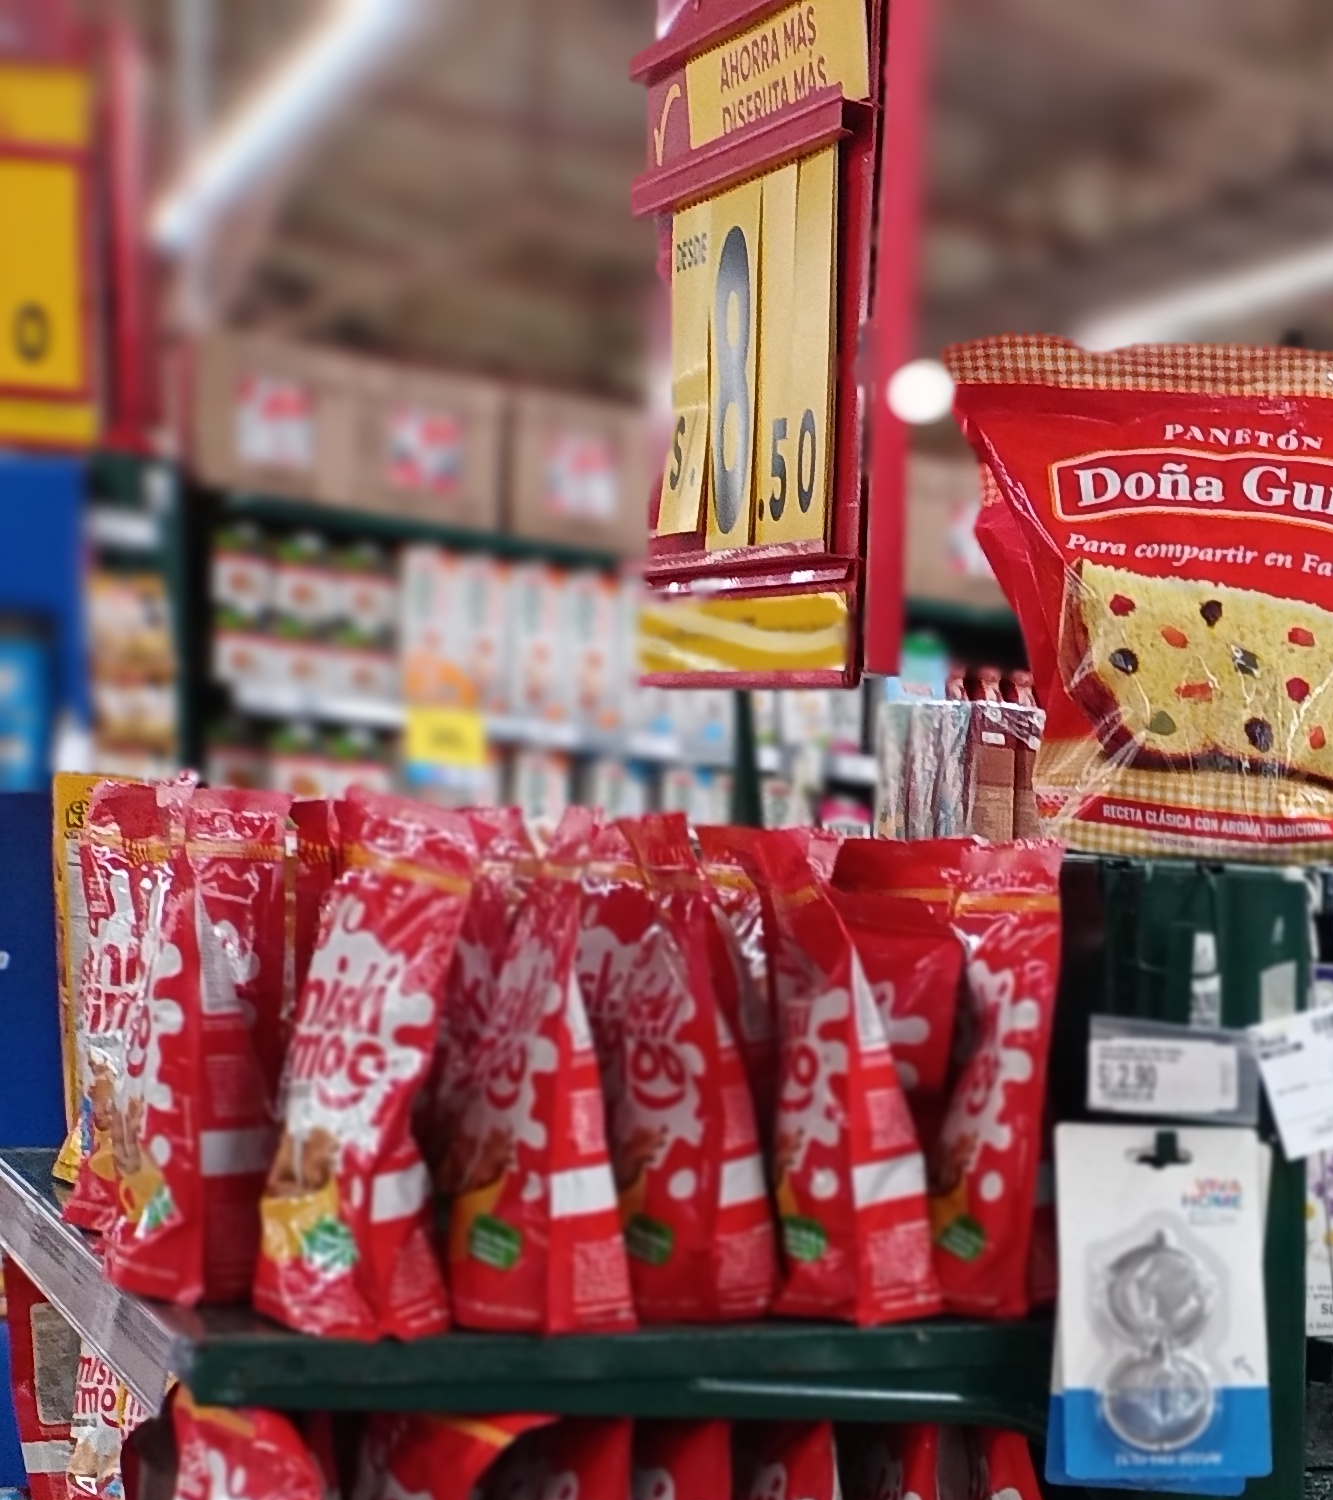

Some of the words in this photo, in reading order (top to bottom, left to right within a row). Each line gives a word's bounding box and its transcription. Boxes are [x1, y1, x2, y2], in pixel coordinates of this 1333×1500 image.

[720, 28, 781, 94] AHORRA
[793, 50, 827, 100] MÁS
[674, 232, 709, 273] DESDE
[712, 225, 751, 536] 8
[1163, 422, 1325, 451] PANETÓN
[1075, 463, 1226, 508] Doña
[1065, 532, 1128, 558] Para
[1134, 539, 1259, 565] compartir
[1264, 549, 1293, 569] en
[1102, 804, 1144, 823] RECETA
[1146, 809, 1191, 829] CLÁSICA
[1194, 816, 1221, 833] CON
[1224, 818, 1262, 837] AROMA
[1264, 820, 1333, 839] TRADICIONAL
